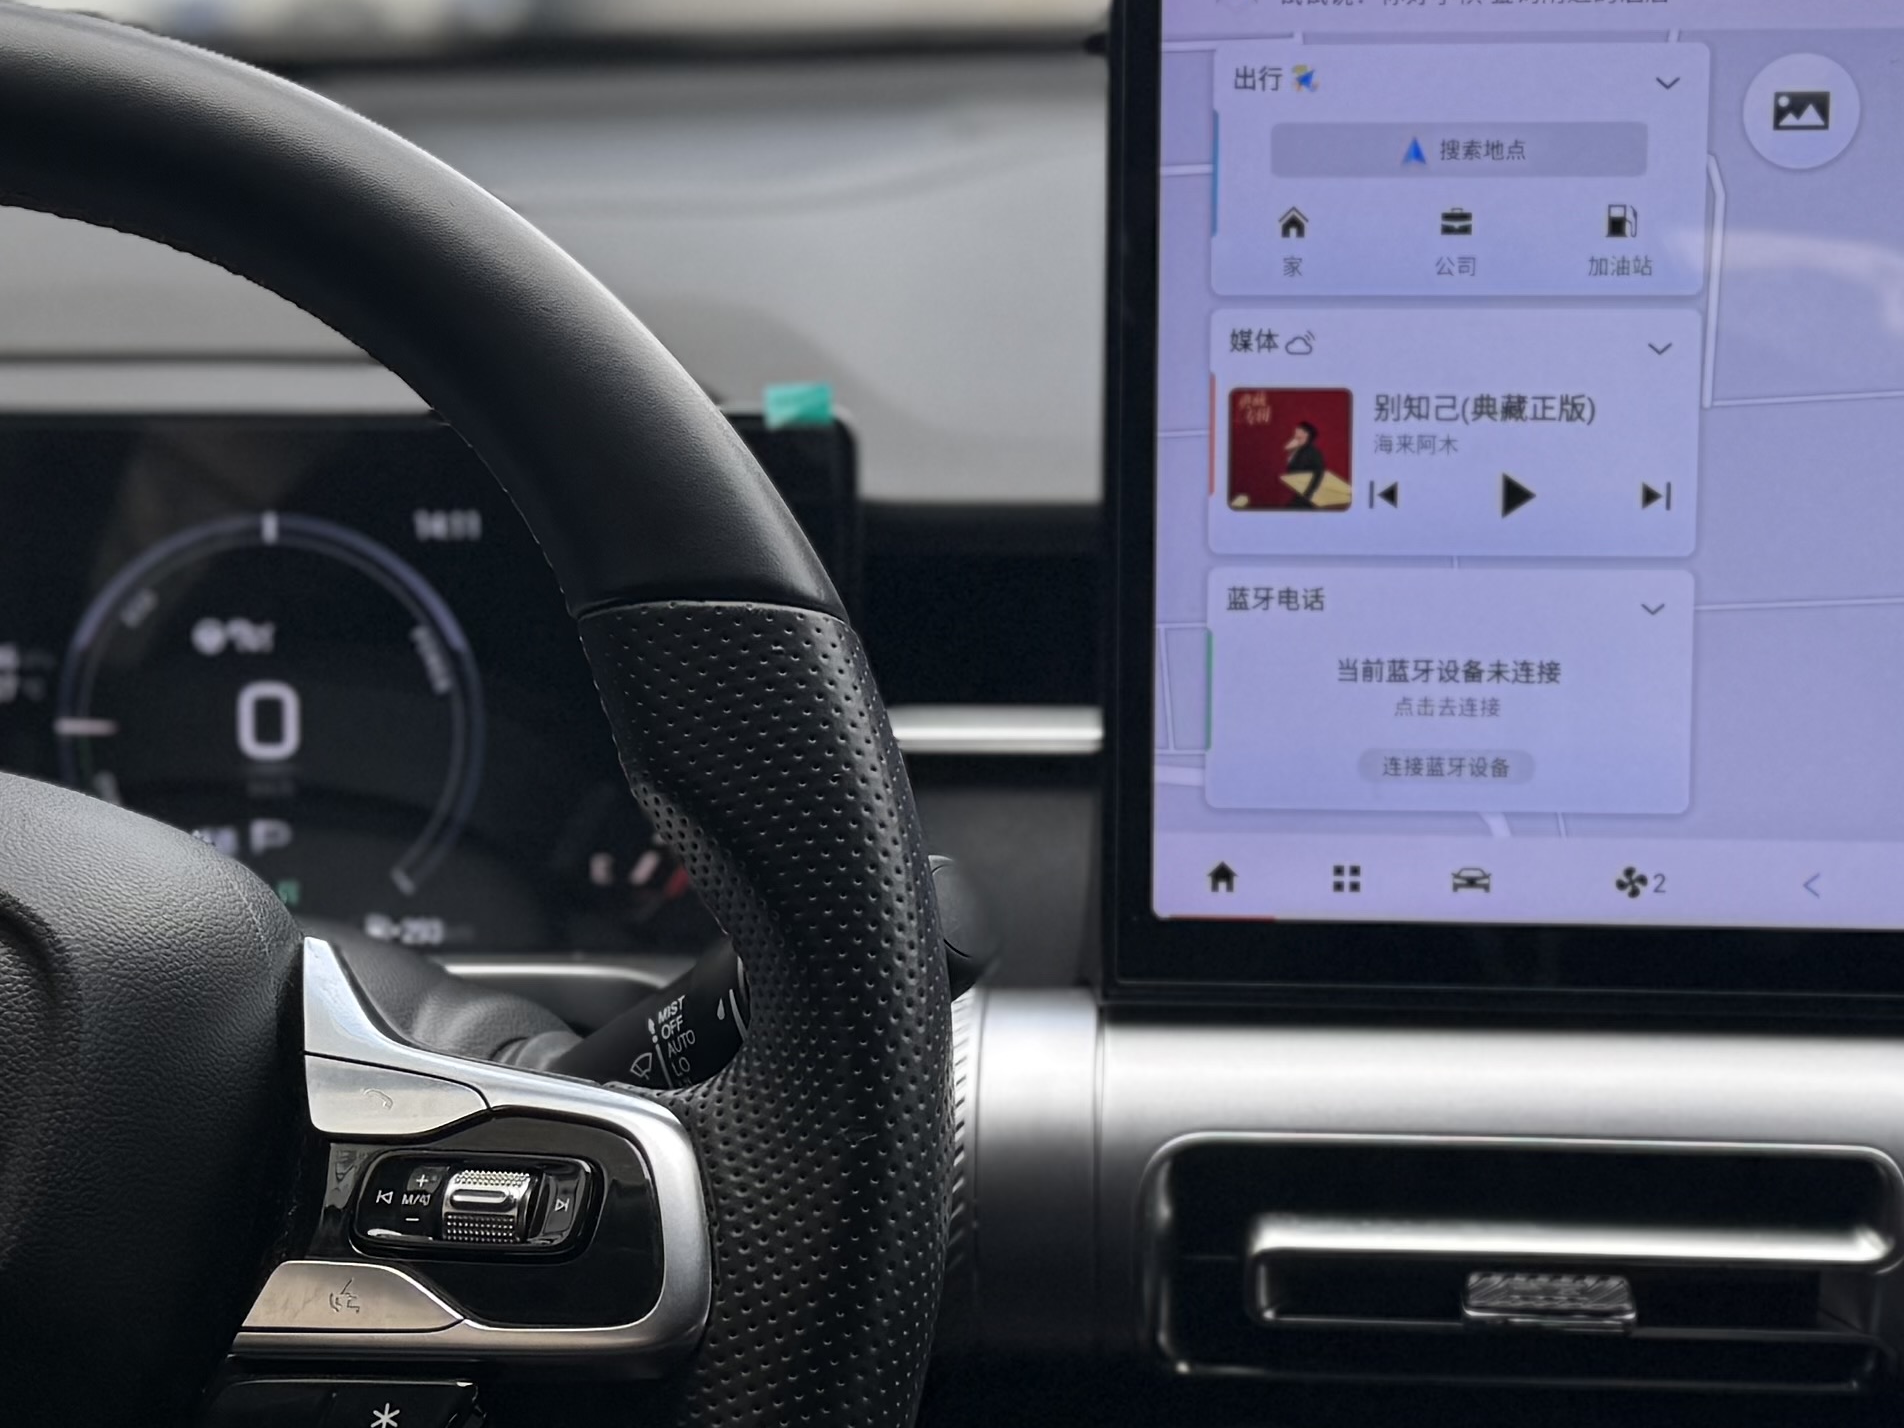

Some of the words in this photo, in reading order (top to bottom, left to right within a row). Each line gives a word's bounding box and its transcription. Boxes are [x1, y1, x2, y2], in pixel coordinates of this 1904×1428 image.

[1233, 66, 1283, 92] 出行
[1439, 139, 1527, 162] 搜索地点
[1281, 255, 1304, 277] 家
[1435, 255, 1477, 277] 公司
[1587, 254, 1654, 278] 加油站
[1229, 328, 1280, 354] 媒体
[1373, 394, 1597, 426] 别知己(典藏正版)
[1373, 434, 1459, 456] 海来阿木
[1226, 586, 1326, 613] 蓝牙电话
[1337, 658, 1562, 686] 当前蓝牙设备未连接
[236, 680, 300, 760] 0
[1393, 697, 1501, 719] 点击去连接
[1382, 756, 1511, 779] 连接蓝牙设备
[1653, 873, 1667, 894] 2
[657, 994, 686, 1024] MIST
[661, 1014, 684, 1040] OFF
[667, 1029, 696, 1059] AUTO
[671, 1056, 691, 1077] LO
